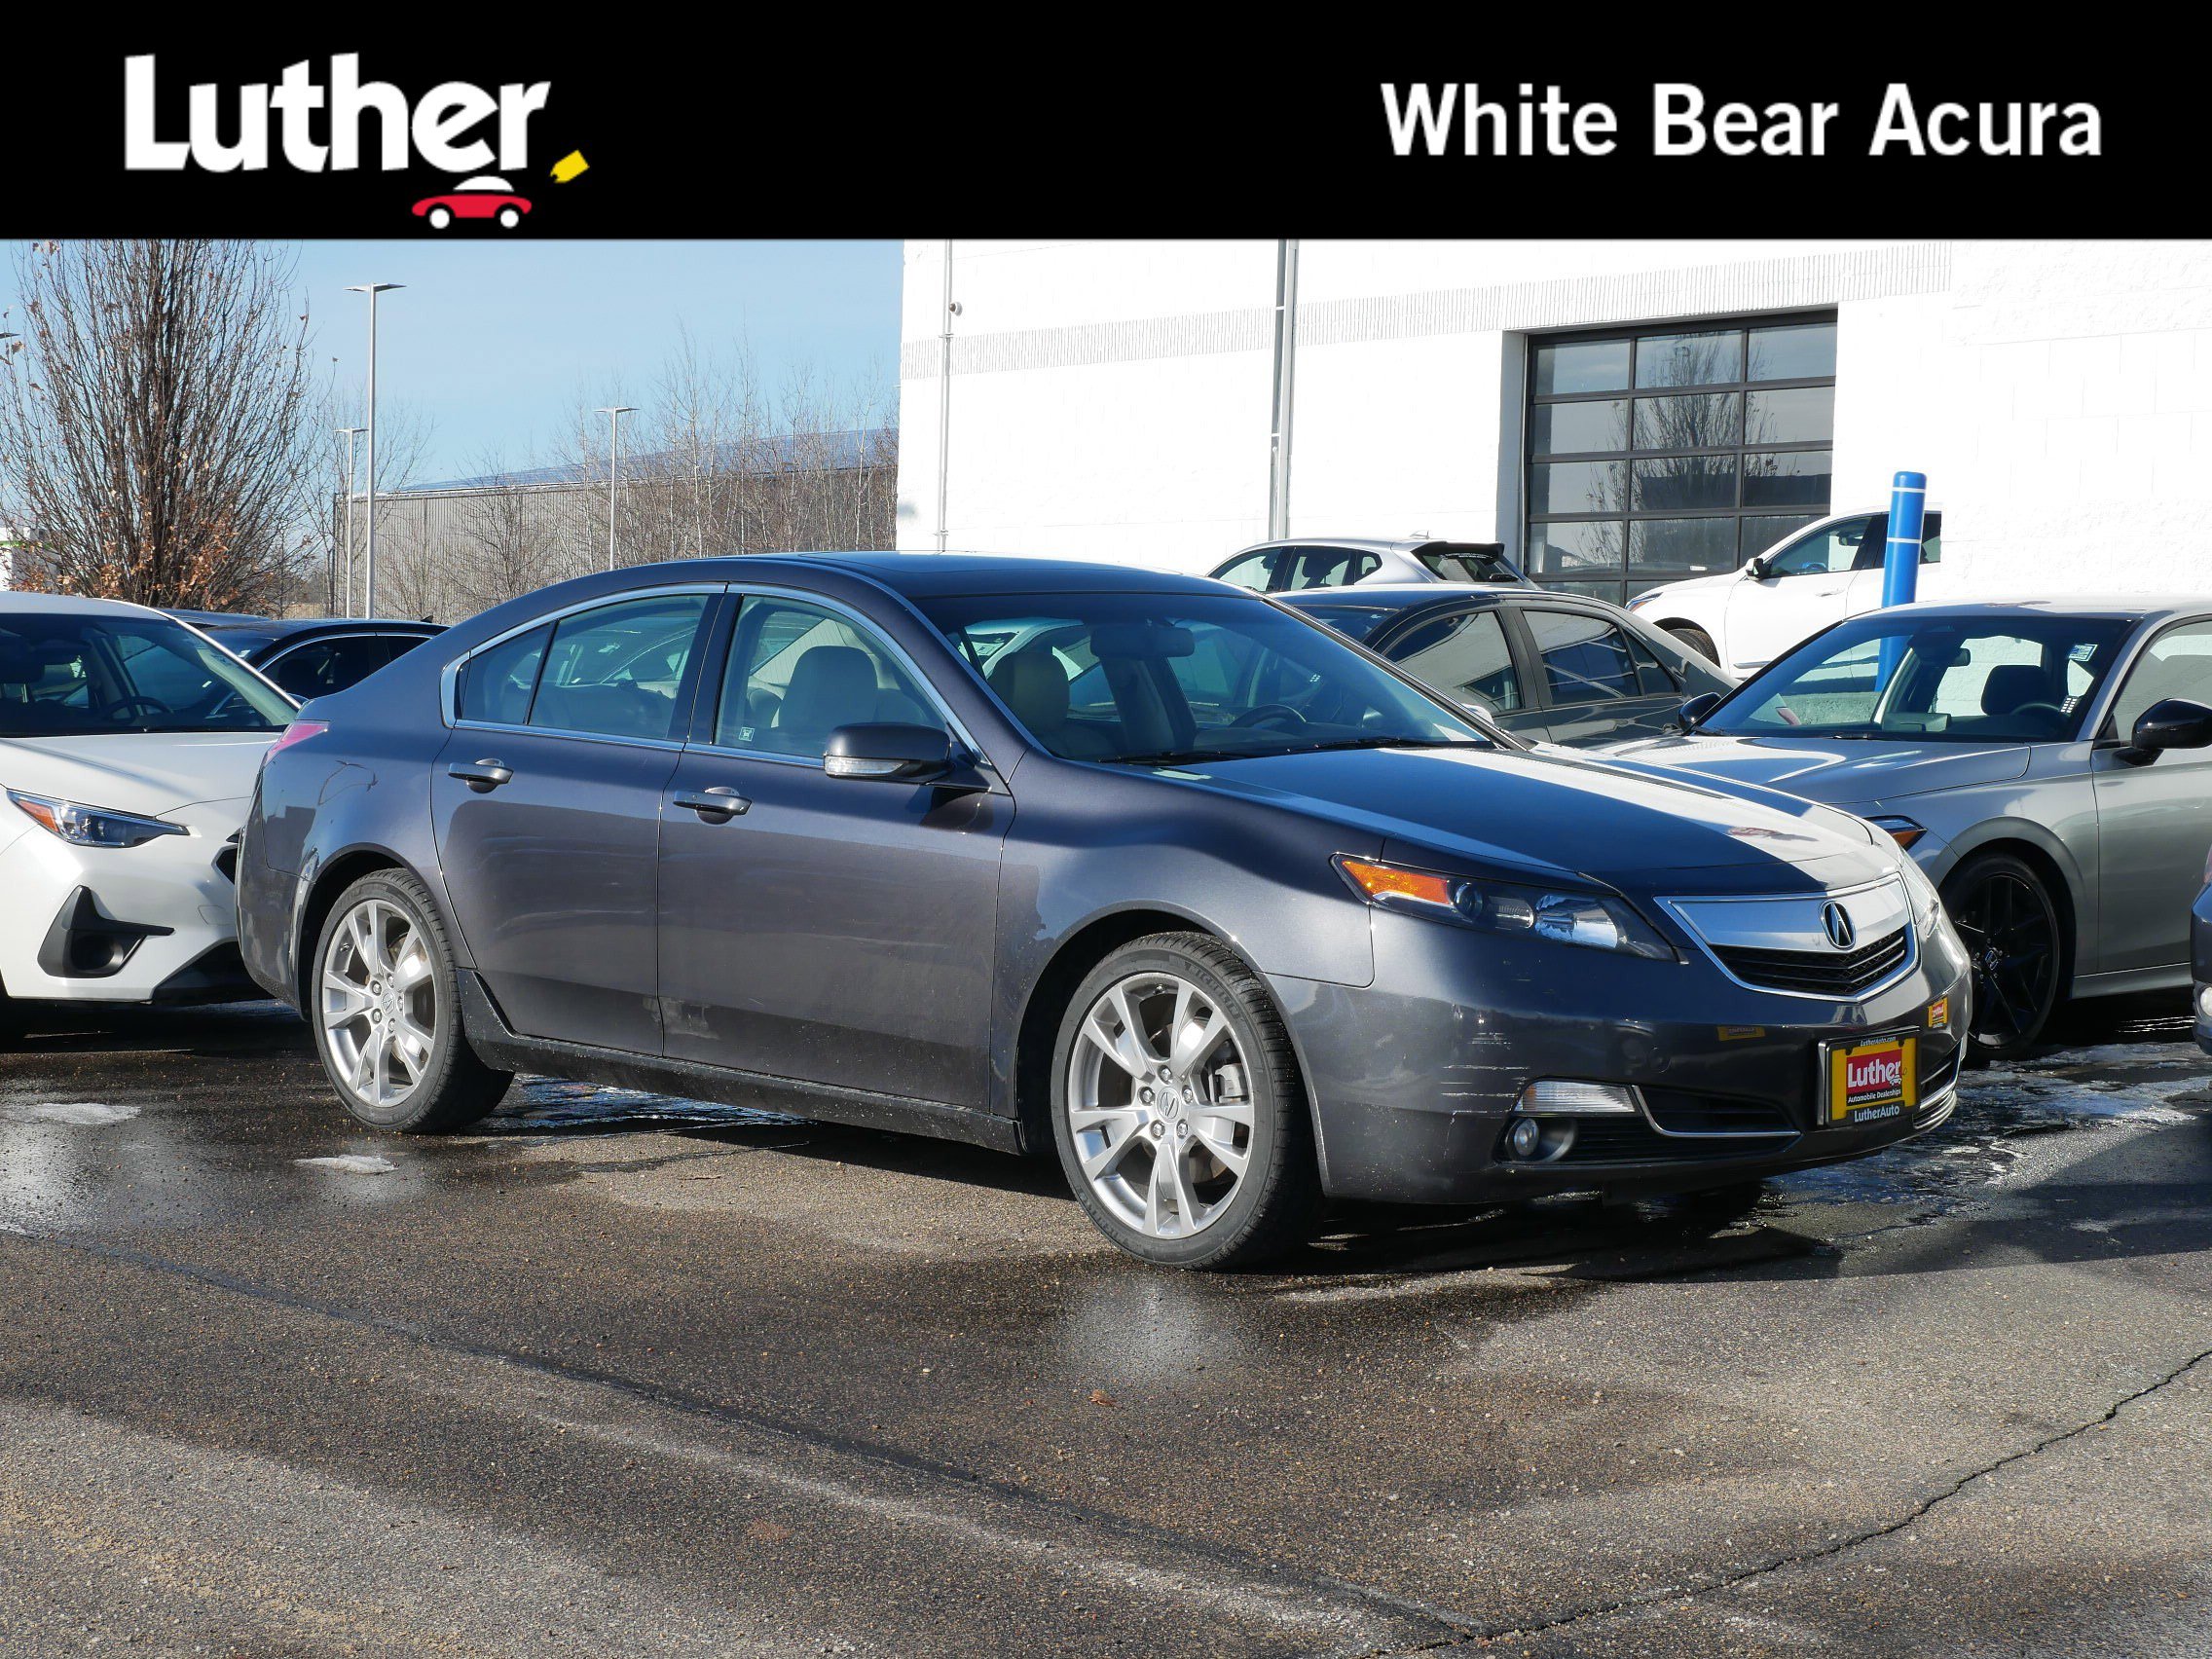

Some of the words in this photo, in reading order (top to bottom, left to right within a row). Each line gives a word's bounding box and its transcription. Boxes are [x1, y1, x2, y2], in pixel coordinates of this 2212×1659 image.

[1860, 1036, 1897, 1047] LutherAuto.com
[1847, 1058, 1901, 1088] Luther
[1848, 1092, 1876, 1104] Automobile
[1876, 1088, 1901, 1099] Dealerships
[1854, 1105, 1900, 1123] LutherAuto
